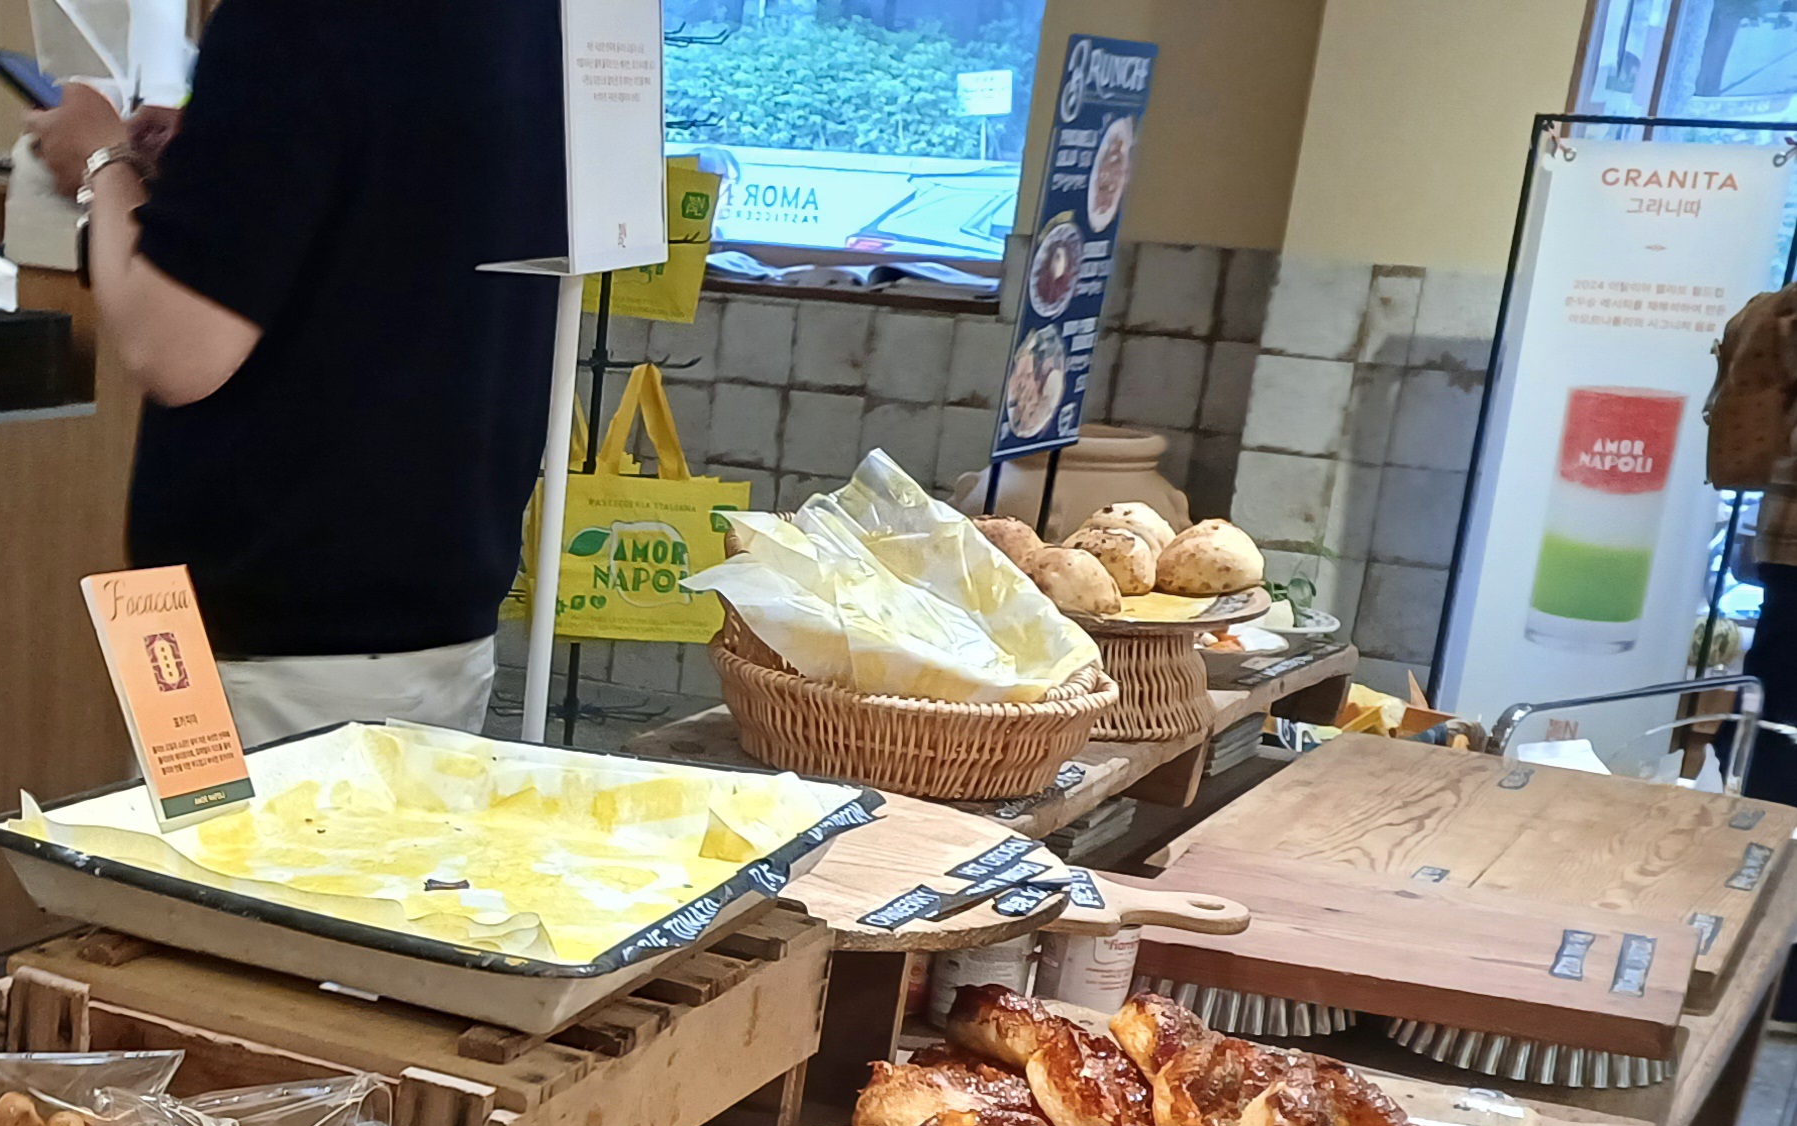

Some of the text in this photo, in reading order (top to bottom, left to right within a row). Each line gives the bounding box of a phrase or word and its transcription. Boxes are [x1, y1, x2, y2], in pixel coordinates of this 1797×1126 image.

[1593, 438, 1645, 456] AMOR
[1579, 451, 1653, 473] NAPOLI
[613, 538, 689, 565] AMOR
[593, 564, 705, 594] NAPOL
[104, 579, 190, 621] Focaccia
